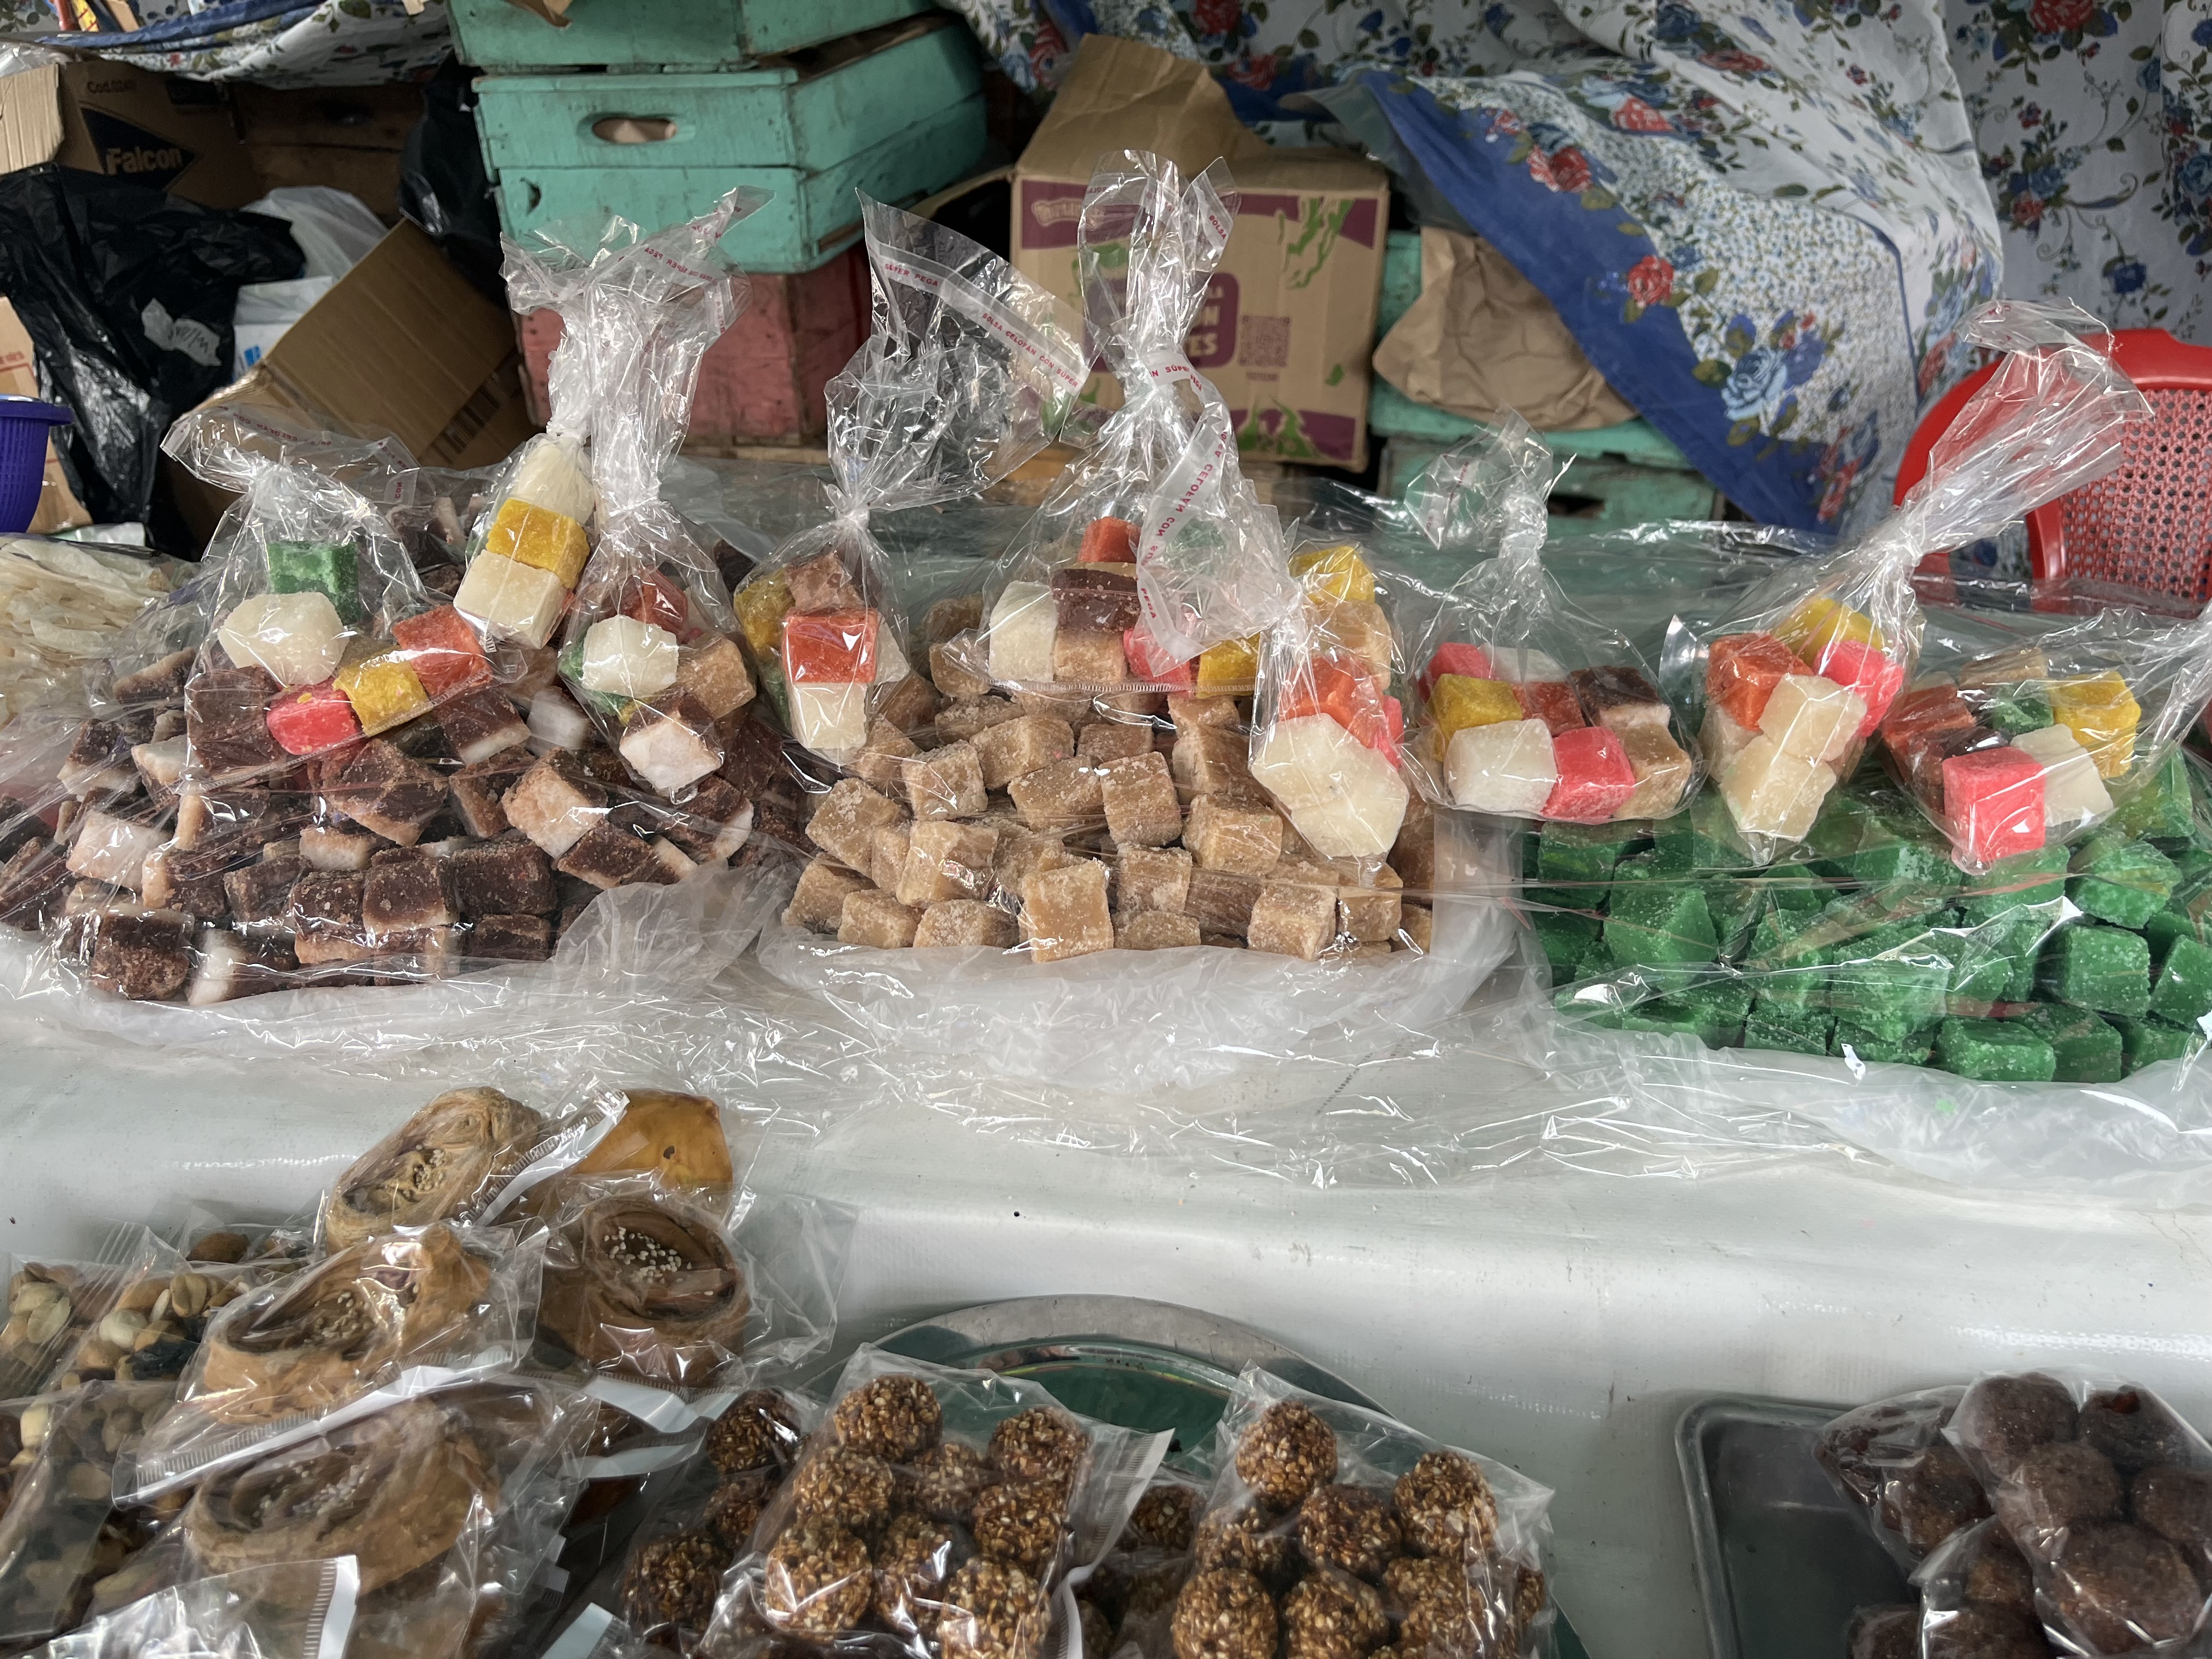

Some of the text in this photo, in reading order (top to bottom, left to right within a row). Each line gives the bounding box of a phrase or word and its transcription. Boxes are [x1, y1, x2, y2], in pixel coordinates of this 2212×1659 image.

[106, 146, 183, 176] Falcon
[1209, 215, 1227, 240] BOLSA
[914, 273, 939, 287] PEGA
[982, 313, 1079, 388] BOLSA CELOFÁN CON SÚPER
